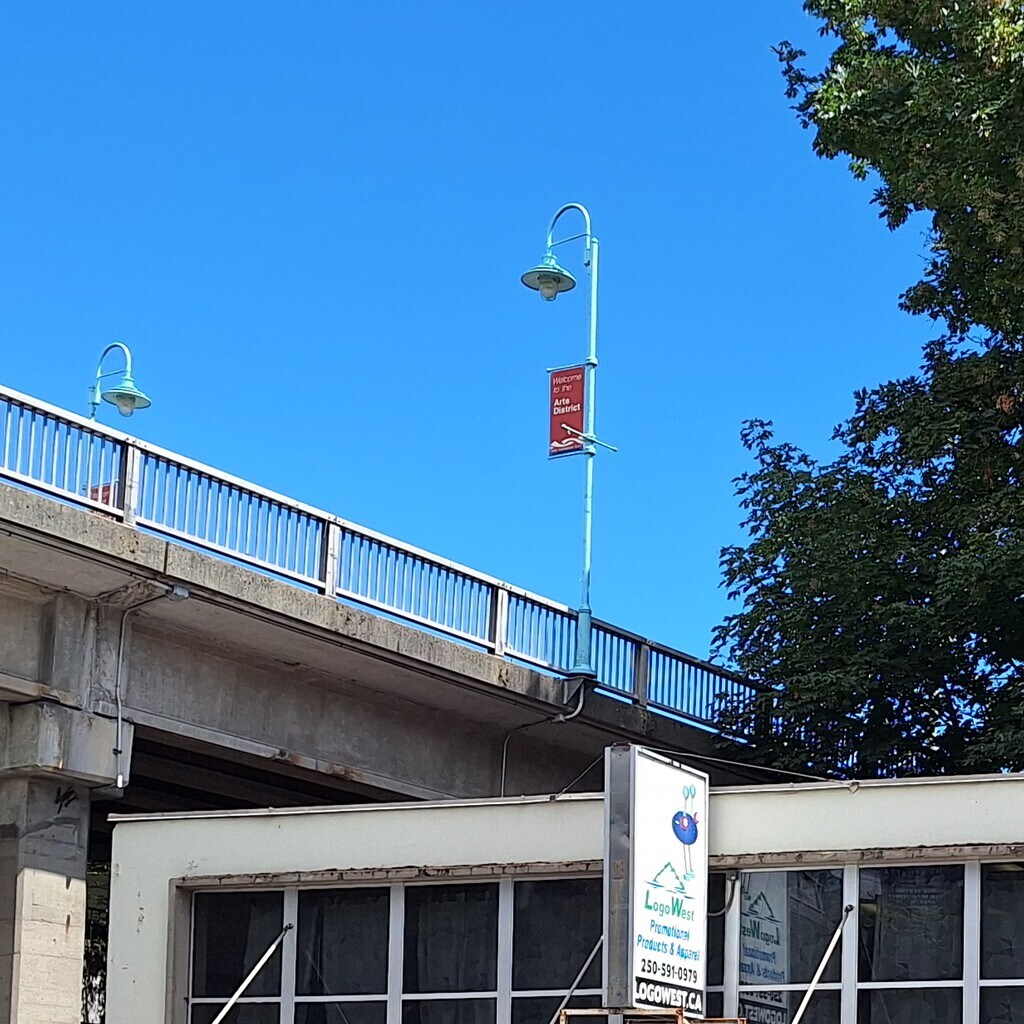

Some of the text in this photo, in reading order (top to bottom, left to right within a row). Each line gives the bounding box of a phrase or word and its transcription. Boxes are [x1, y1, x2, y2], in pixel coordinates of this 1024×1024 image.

[553, 373, 582, 385] Welcome
[553, 384, 573, 394] to the
[553, 398, 570, 407] Arts
[553, 404, 580, 415] District
[650, 919, 691, 942] Promotional
[637, 934, 700, 961] Products & Apparel
[640, 958, 698, 984] 250-591-0979
[634, 980, 703, 1012] LOGOWEST.CA
